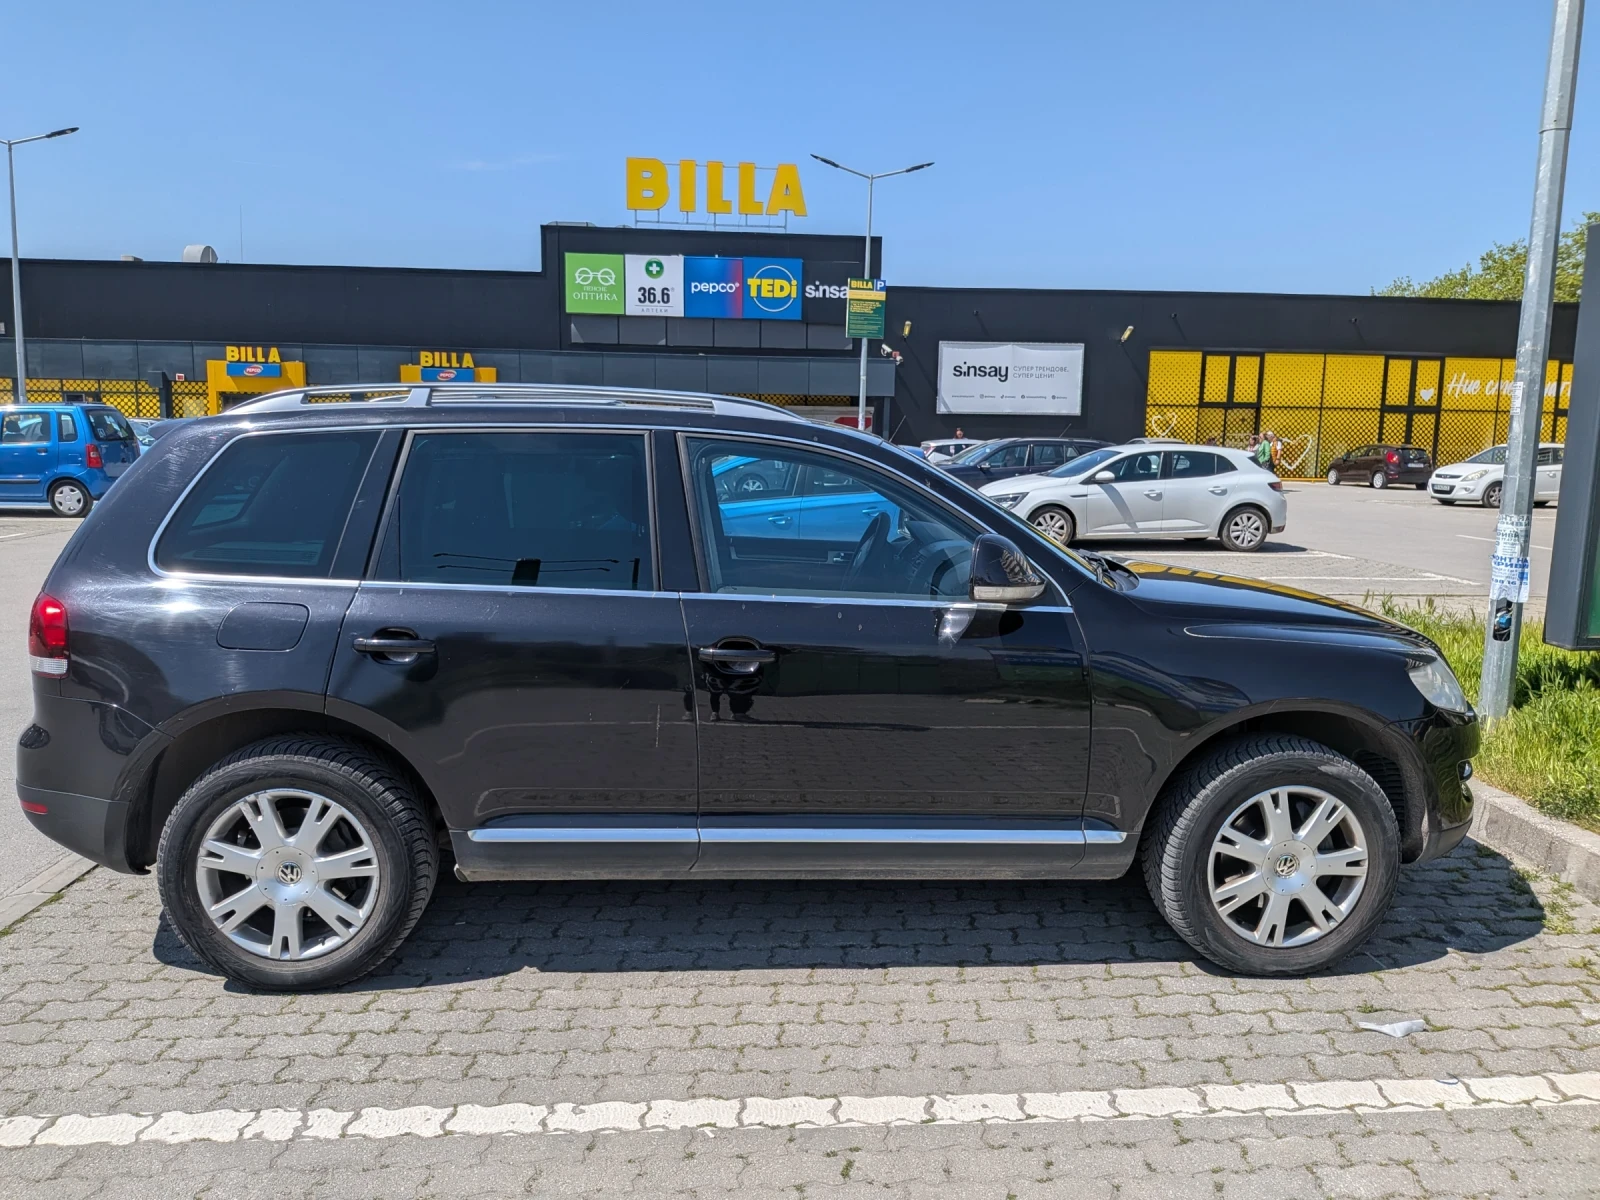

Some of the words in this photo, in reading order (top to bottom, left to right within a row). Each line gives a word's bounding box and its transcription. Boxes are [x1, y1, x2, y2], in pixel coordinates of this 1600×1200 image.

[626, 157, 808, 217] BILLA
[691, 281, 736, 294] pepco
[747, 278, 798, 299] TEDi
[804, 280, 849, 299] sinsa
[851, 280, 873, 289] BILLA
[572, 291, 618, 301] ОПТИКА
[637, 286, 671, 305] 36.6
[225, 345, 281, 363] BILLA
[420, 351, 475, 369] BILLA
[952, 361, 1009, 383] sinsay
